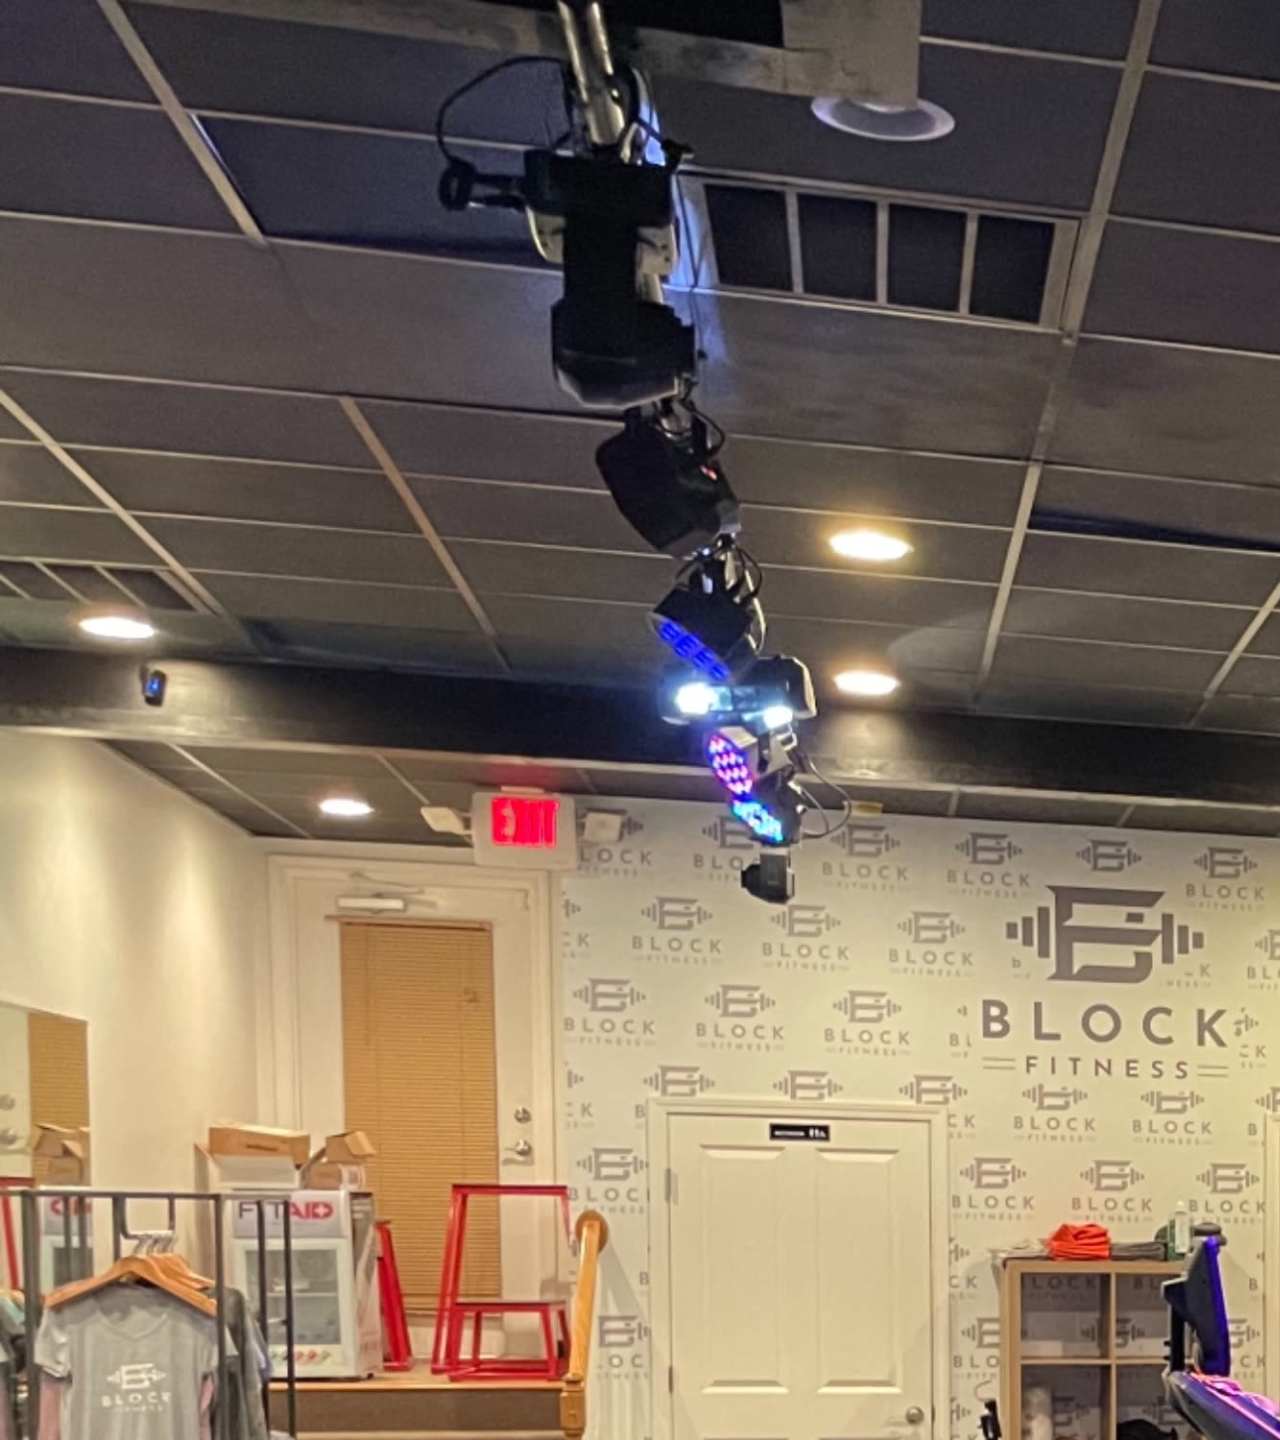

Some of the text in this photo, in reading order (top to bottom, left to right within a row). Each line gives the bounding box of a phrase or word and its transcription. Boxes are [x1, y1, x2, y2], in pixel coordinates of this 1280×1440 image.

[580, 847, 653, 866] LOCK
[822, 862, 910, 881] BLOCK
[947, 870, 1030, 887] BLOCK
[1186, 884, 1265, 900] BLOCK
[632, 936, 721, 954] BLOCK
[762, 942, 849, 960] BLOCK
[889, 949, 974, 966] BLOCK
[564, 1017, 655, 1035] BLOCK
[696, 1022, 784, 1040] BLOCK
[982, 999, 1228, 1048] BLOCK
[824, 1028, 910, 1045] BLOCK
[1025, 1055, 1189, 1080] FITNESS
[1013, 1116, 1096, 1133] BLOCK
[1133, 1119, 1212, 1135] BLOCK
[239, 1200, 333, 1220] FTAID
[952, 1194, 1035, 1210] BLOCK
[1072, 1197, 1152, 1212] BLOCK
[1032, 1276, 1097, 1291] LOCK
